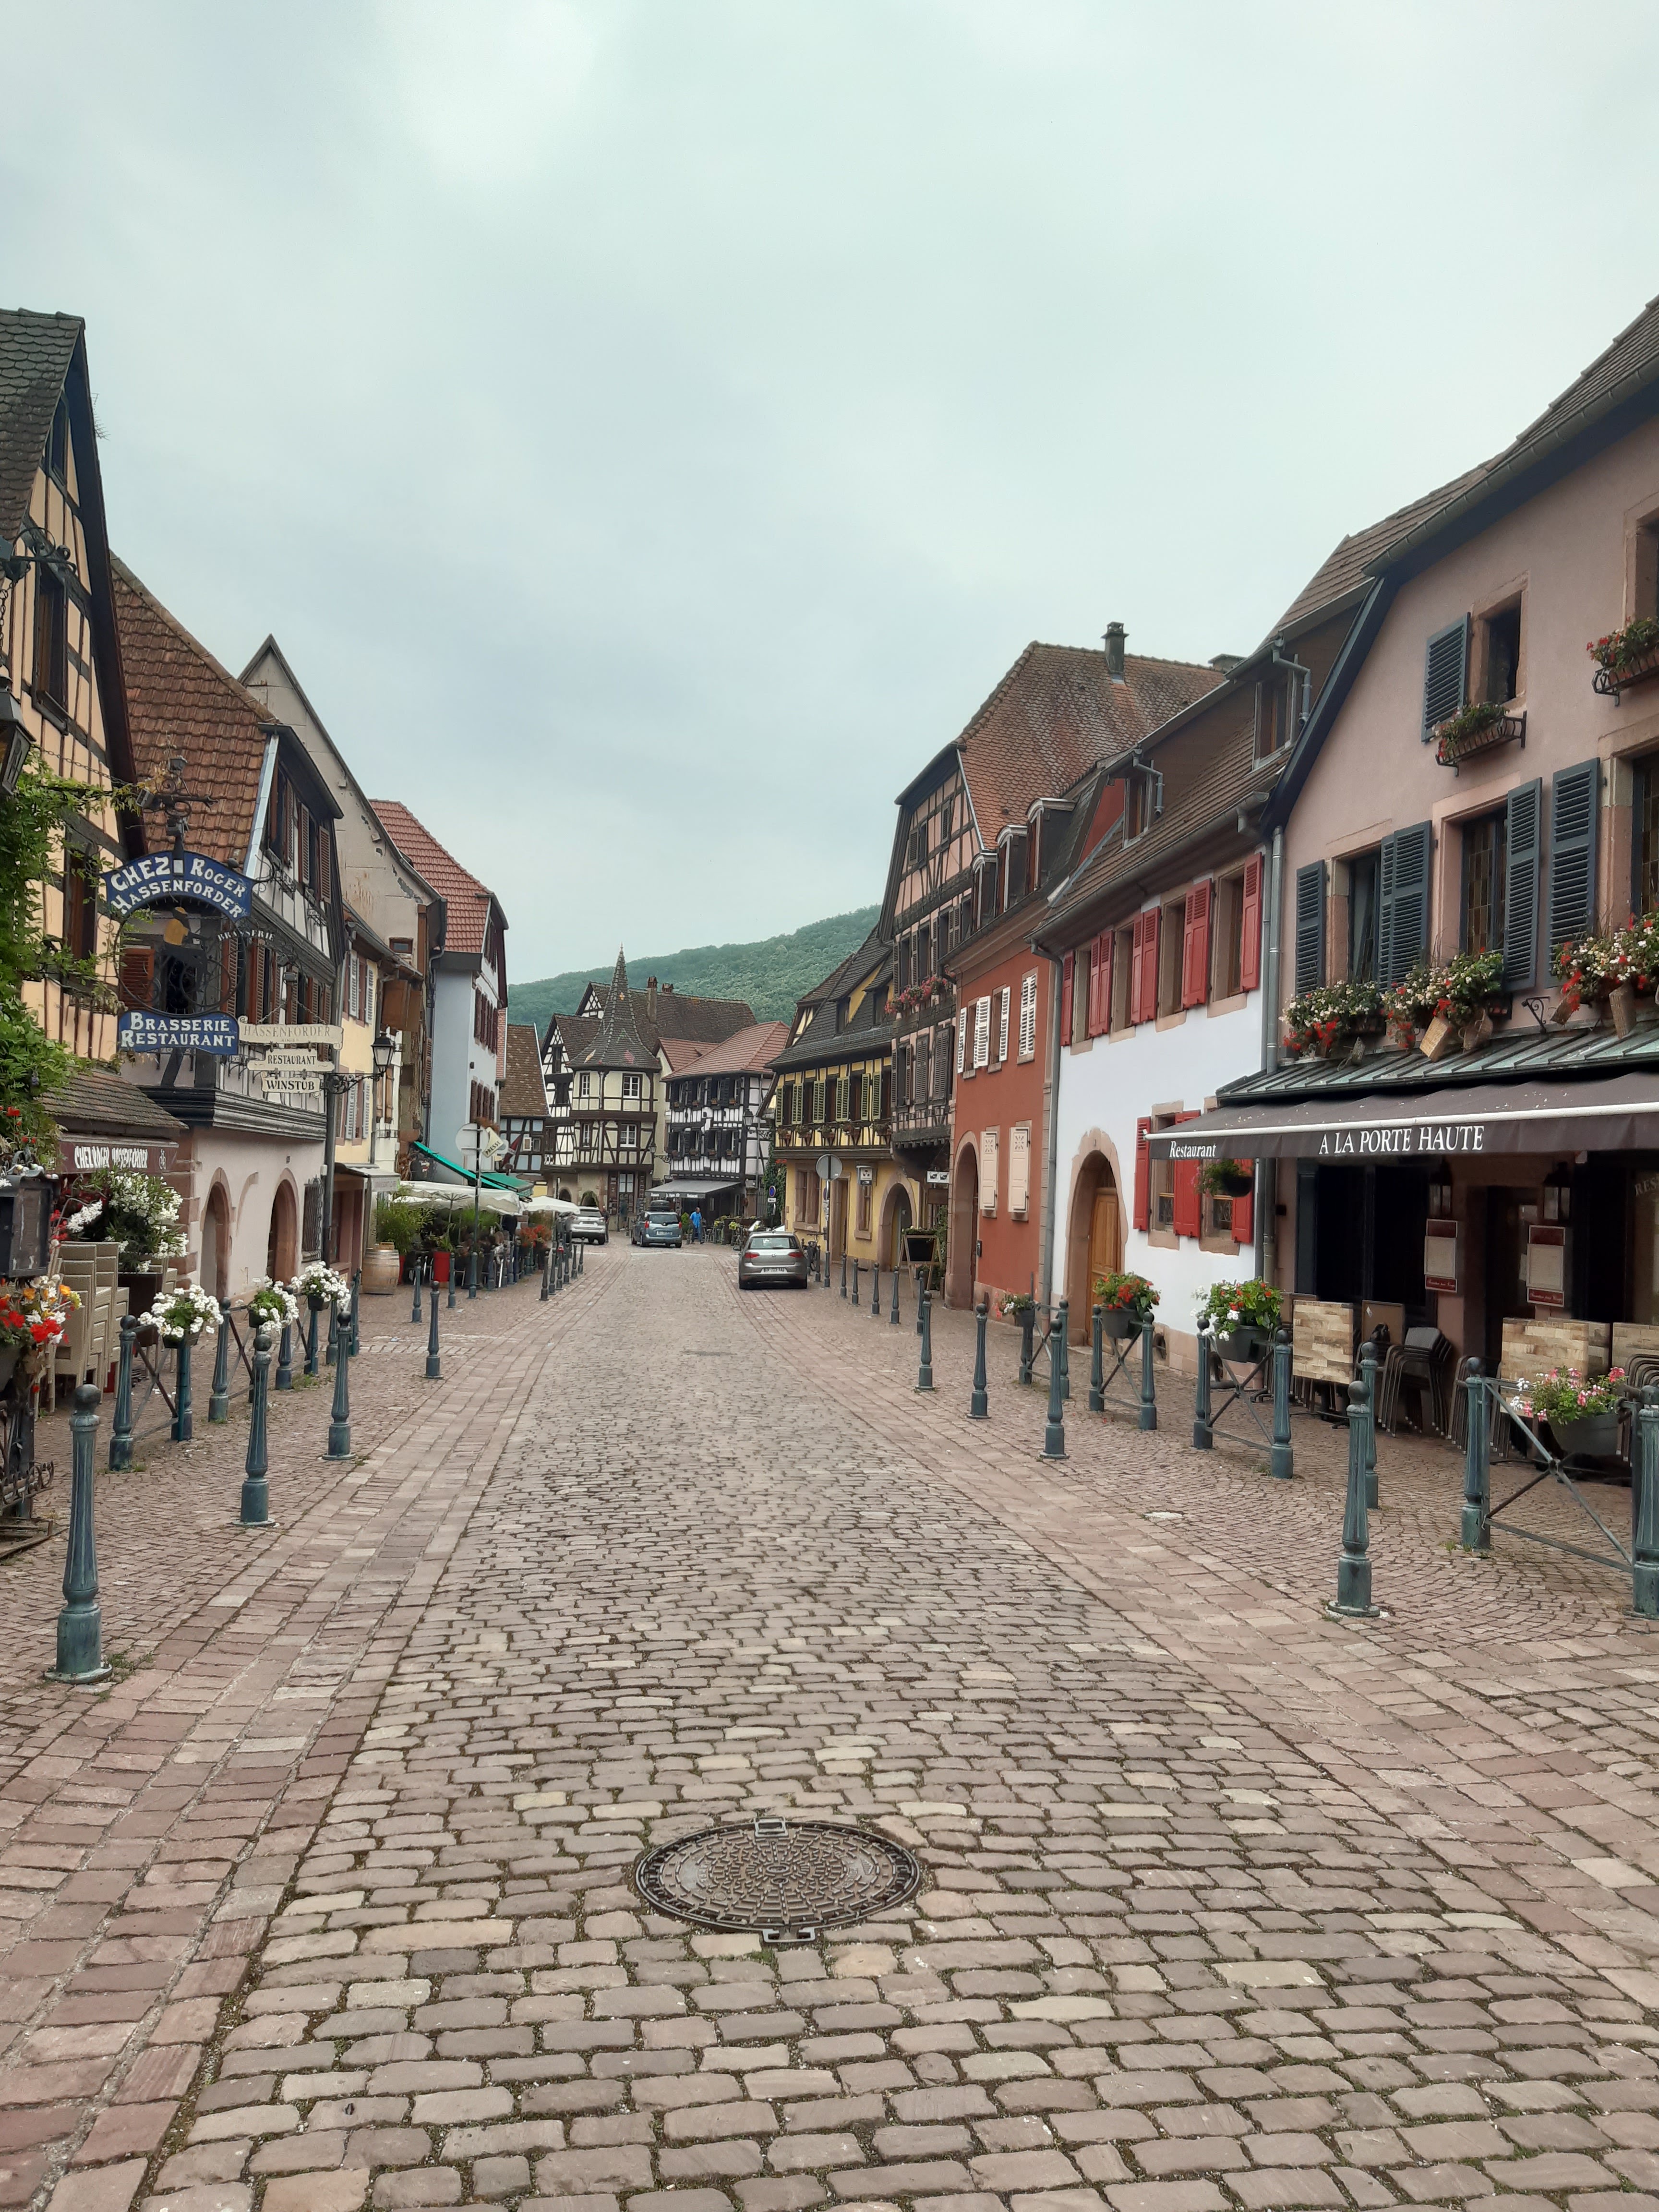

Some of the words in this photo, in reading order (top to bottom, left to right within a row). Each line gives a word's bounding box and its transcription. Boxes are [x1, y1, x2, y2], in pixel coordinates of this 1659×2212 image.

[111, 856, 170, 891] CHEZ
[190, 858, 246, 898] ROGER
[111, 879, 242, 918] HASSENFORDER
[130, 1012, 230, 1032] BRASSERIE
[121, 1030, 235, 1047] RESTAURANT
[244, 1025, 330, 1037] HASSENFORDER
[267, 1055, 316, 1065] RESTAURANT
[266, 1080, 315, 1091] WINSTUB
[485, 1140, 501, 1155] PRESSE
[1319, 1133, 1329, 1154] A
[1334, 1131, 1354, 1154] LA
[1359, 1128, 1412, 1153] PORTE
[1418, 1125, 1485, 1151] HAUTE
[75, 1146, 94, 1168] CHEZ
[1169, 1141, 1216, 1157] Restaurant
